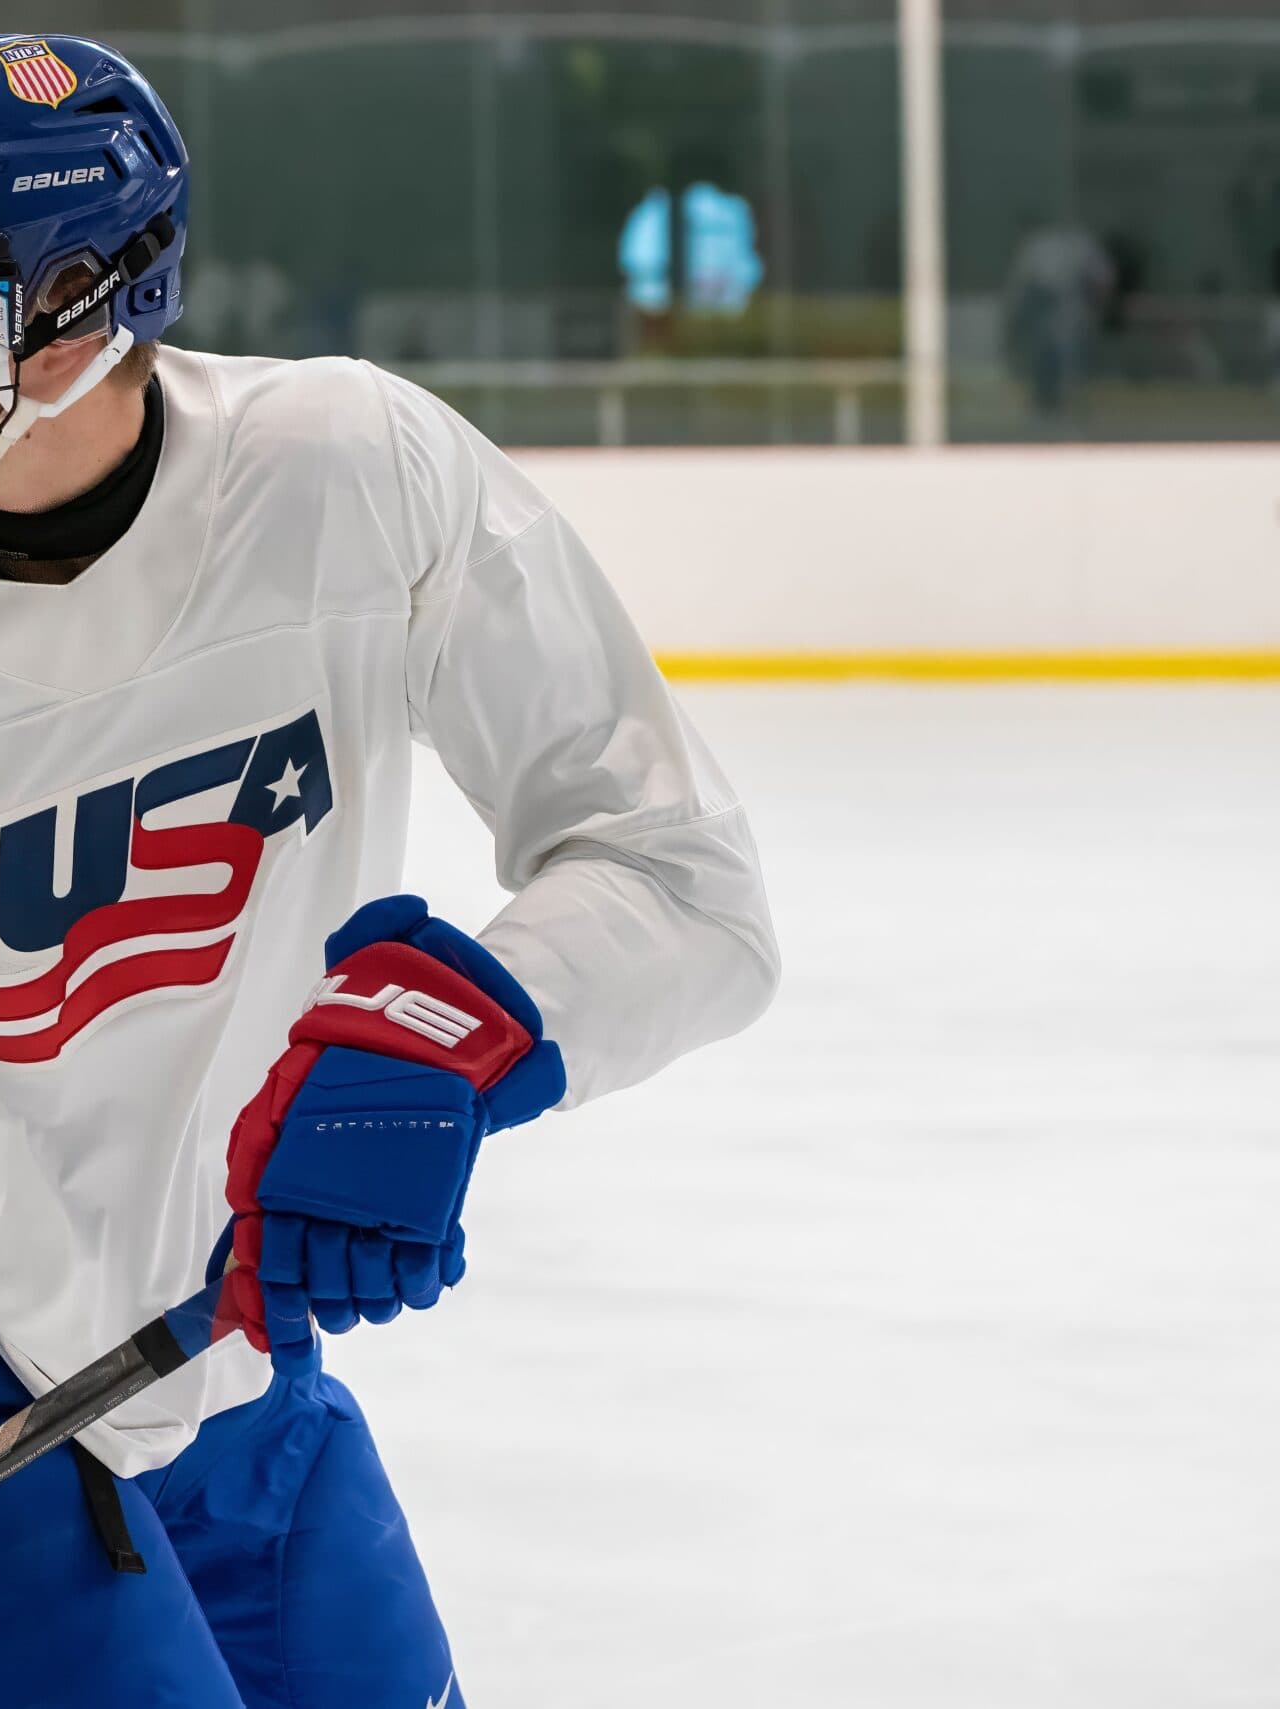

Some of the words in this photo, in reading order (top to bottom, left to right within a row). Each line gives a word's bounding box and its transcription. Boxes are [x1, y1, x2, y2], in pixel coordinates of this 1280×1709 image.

[12, 167, 105, 193] BAUER
[14, 283, 23, 334] BAUER
[56, 270, 120, 329] BAUER
